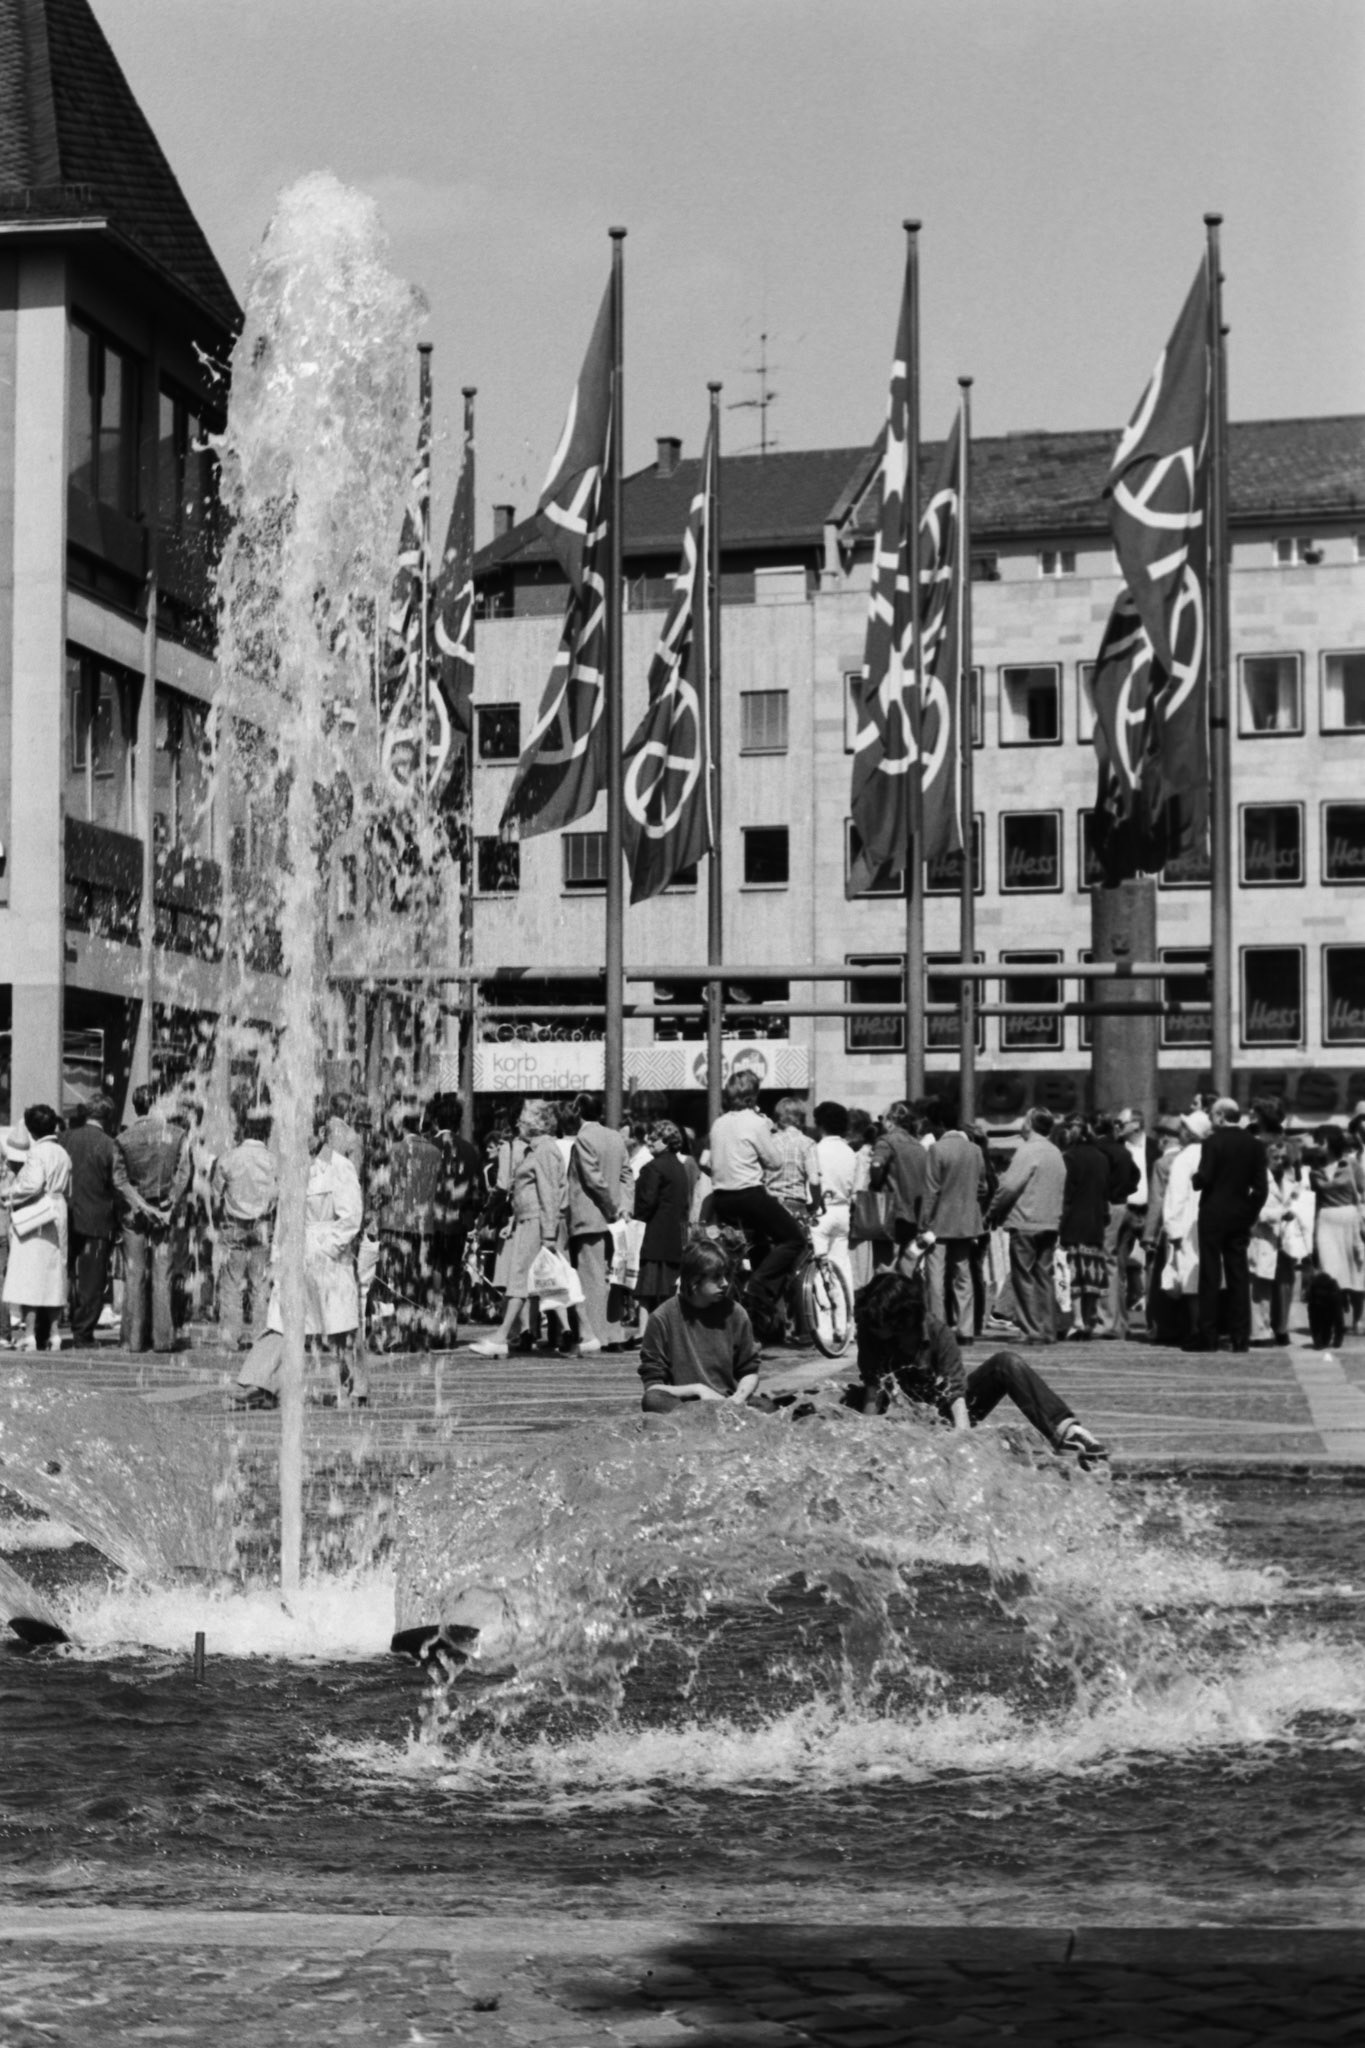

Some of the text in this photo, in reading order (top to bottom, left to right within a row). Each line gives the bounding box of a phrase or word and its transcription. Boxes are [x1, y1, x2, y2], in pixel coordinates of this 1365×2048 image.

[1008, 846, 1055, 876] Hess
[1249, 841, 1297, 869] Hess
[1327, 836, 1365, 868] He
[1249, 998, 1297, 1029] Hess
[1327, 997, 1365, 1029] He
[493, 1053, 537, 1073] korb
[493, 1069, 590, 1091] schneider
